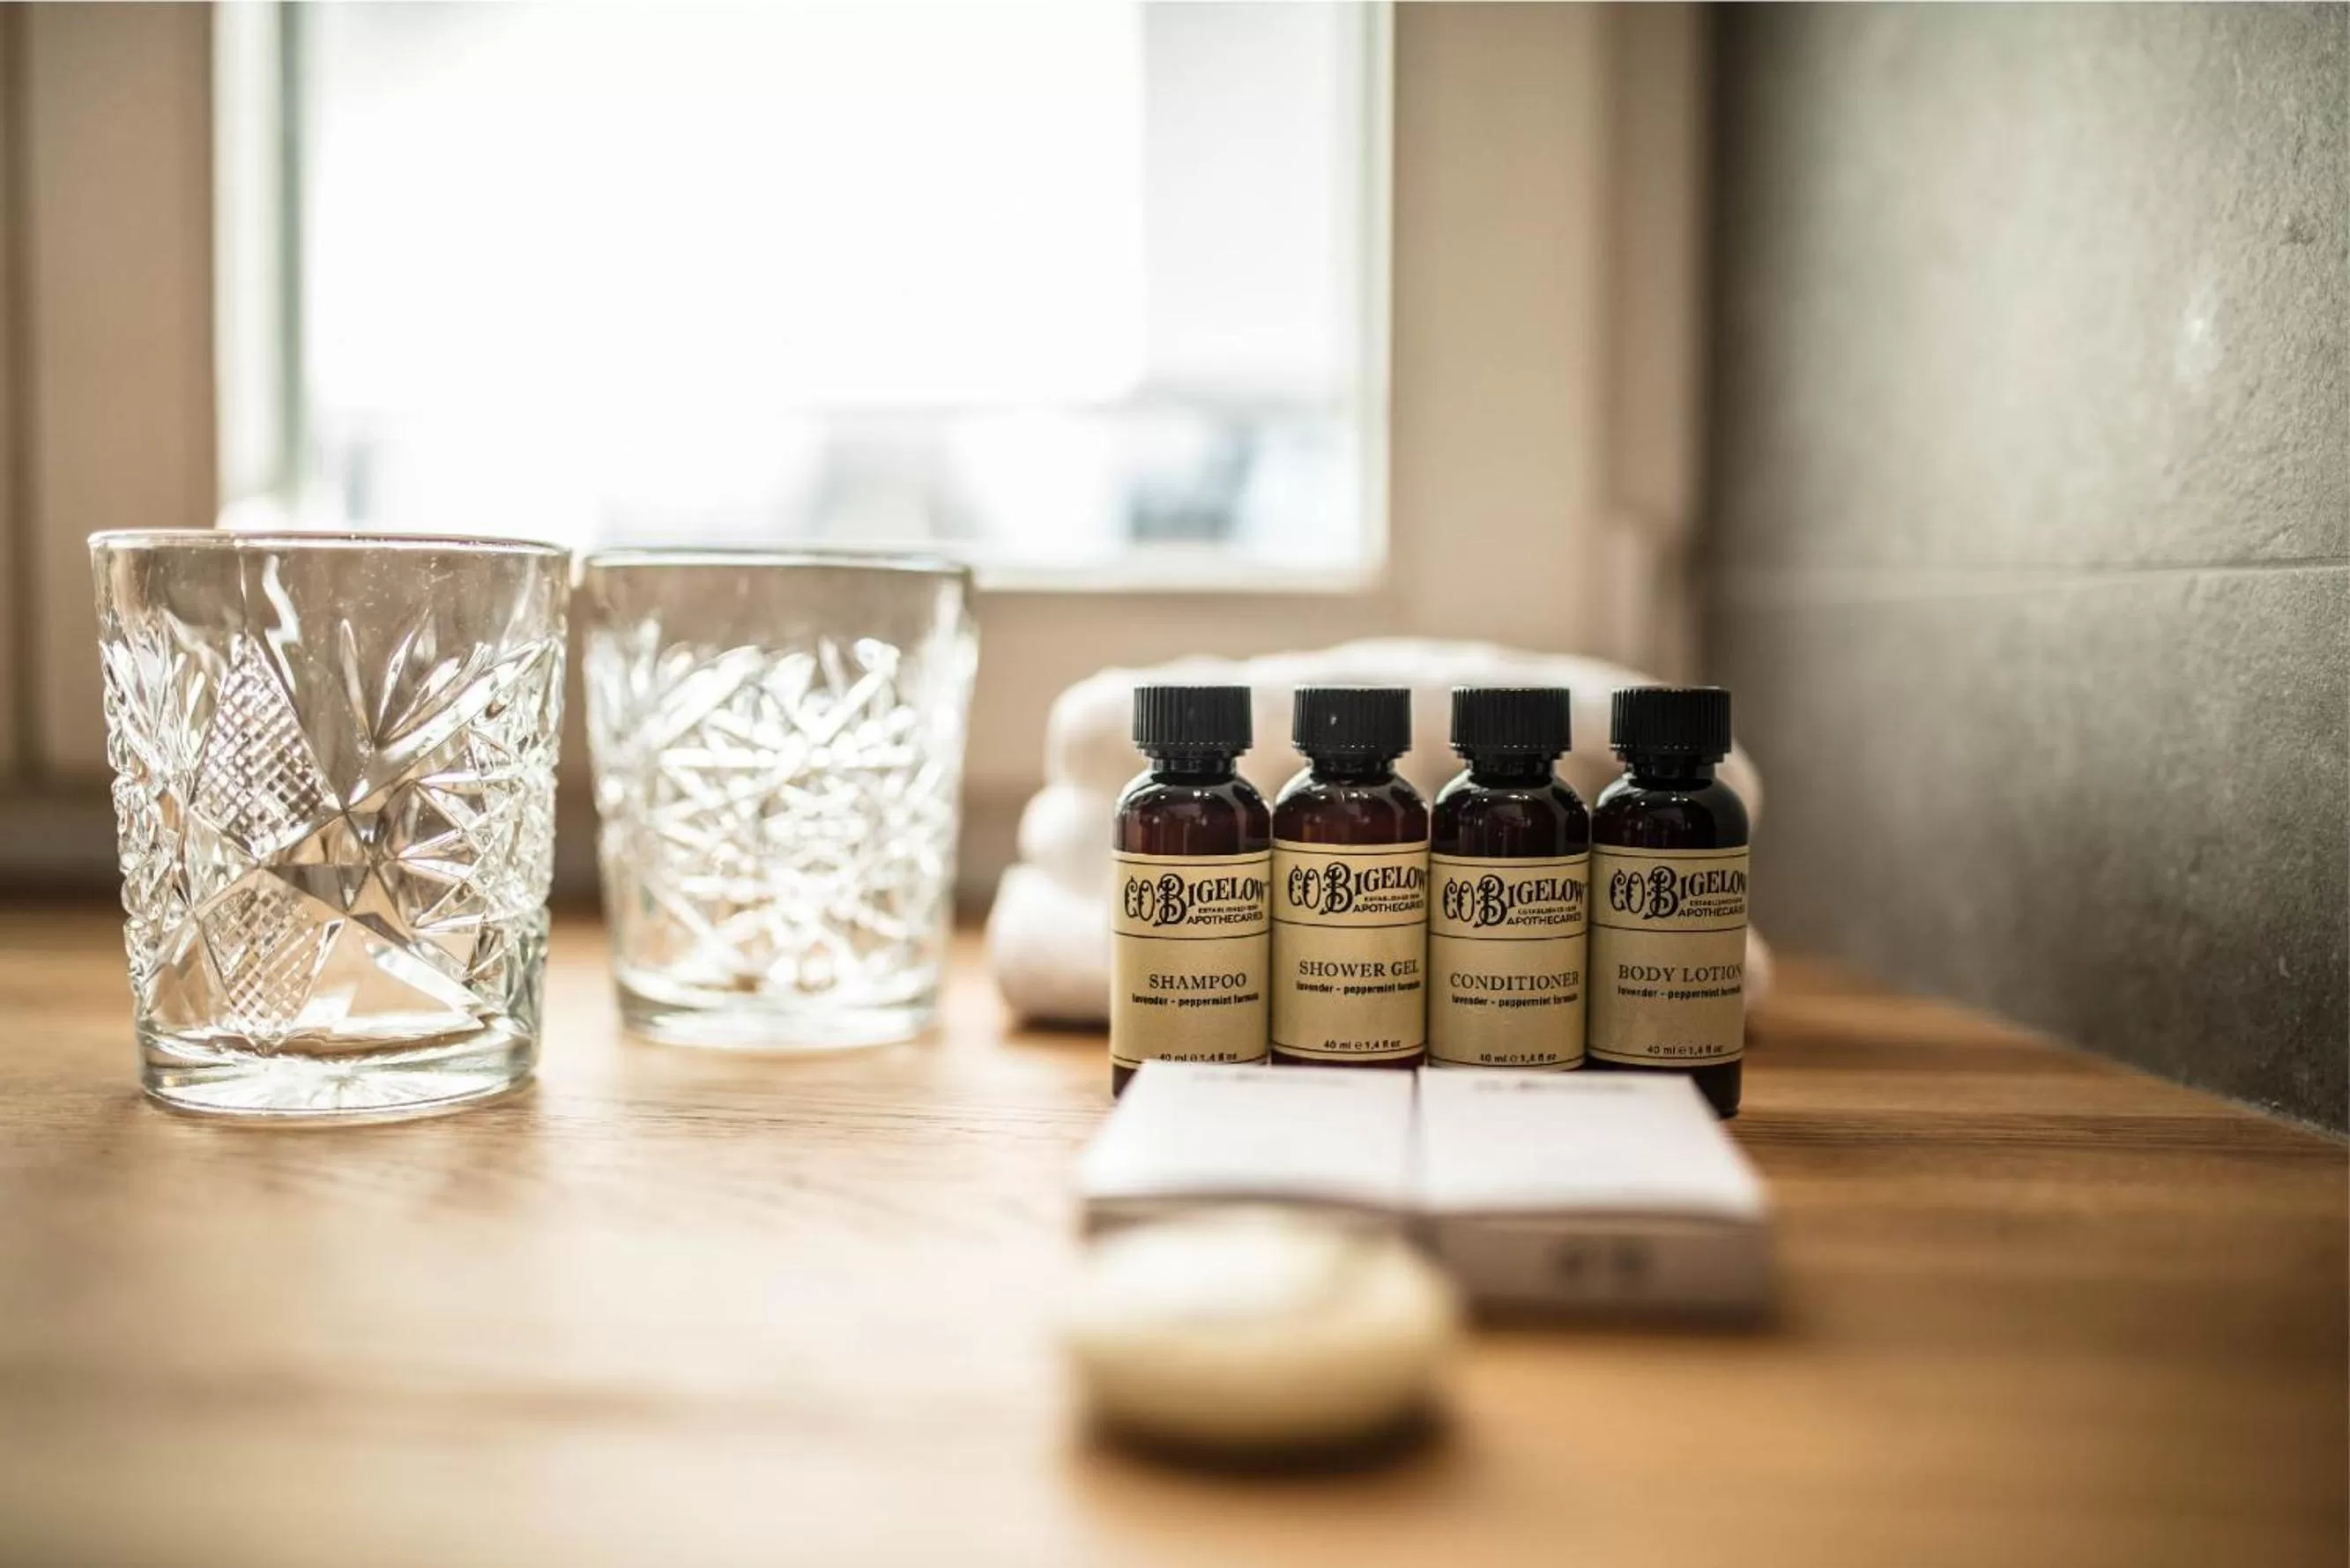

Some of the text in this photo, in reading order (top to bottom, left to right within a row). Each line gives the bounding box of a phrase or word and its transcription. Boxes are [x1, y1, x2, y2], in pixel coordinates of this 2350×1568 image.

[1319, 862, 1425, 915] BIGELOW
[1153, 873, 1264, 926] BIGELOW
[1473, 874, 1585, 927] BIGELOW
[1299, 959, 1419, 977] SHOWER GEL
[1618, 964, 1678, 982] BODY
[1149, 973, 1247, 990] SHAMPOO
[1343, 983, 1395, 995] peppermint
[1450, 971, 1580, 990] CONDITIONER
[1179, 995, 1231, 1007] peppermint
[1498, 996, 1551, 1008] peppermint
[1668, 987, 1720, 1000] peppermint
[1324, 1040, 1336, 1049] 40
[1647, 1045, 1660, 1054] 40
[1663, 1045, 1676, 1054] ml
